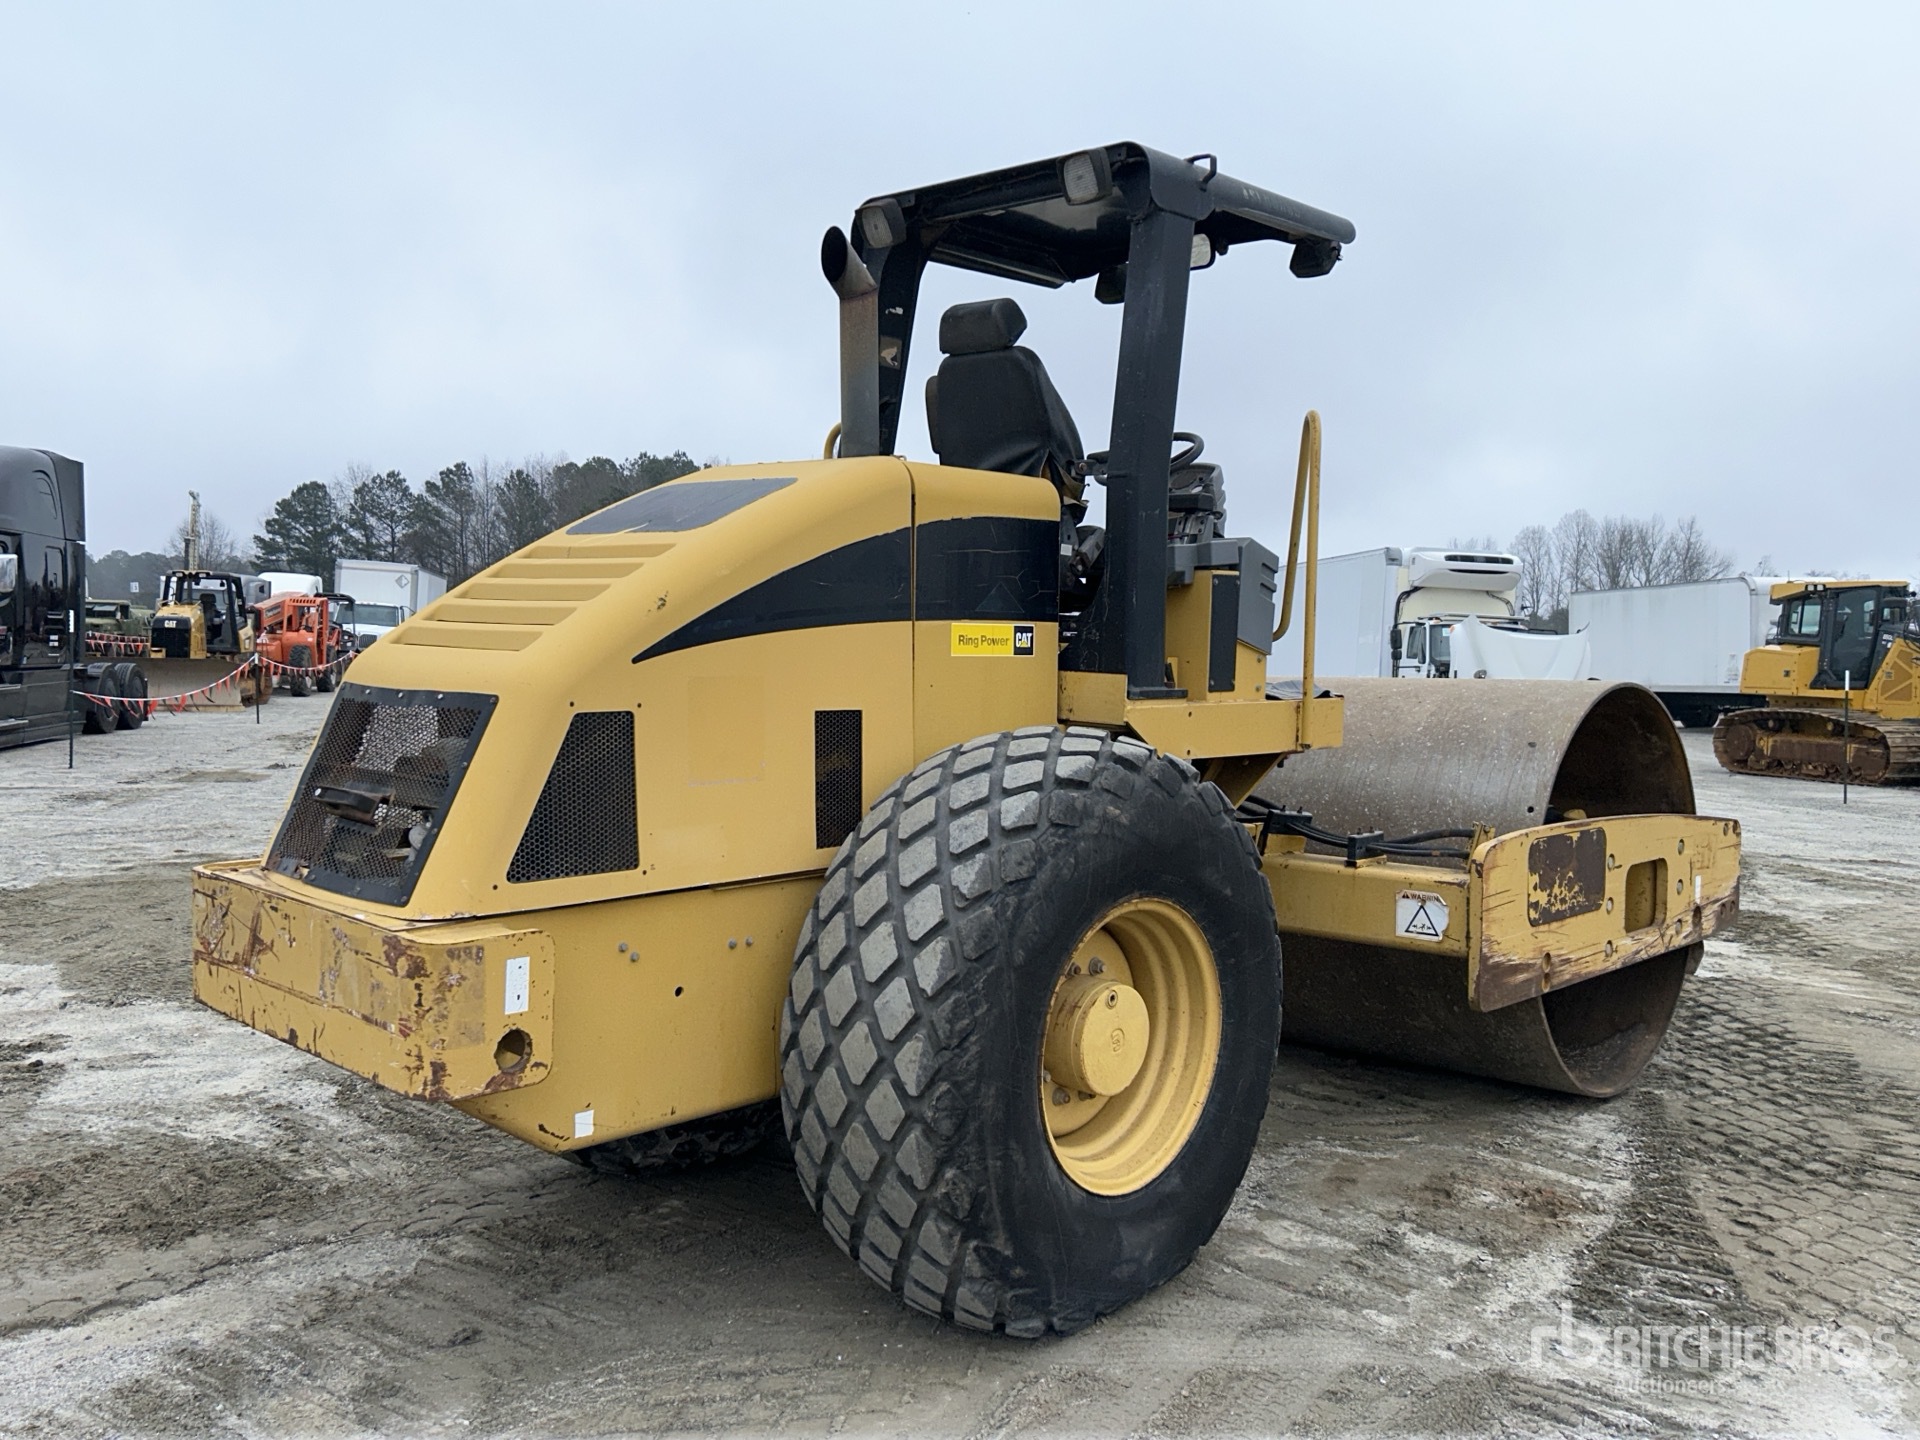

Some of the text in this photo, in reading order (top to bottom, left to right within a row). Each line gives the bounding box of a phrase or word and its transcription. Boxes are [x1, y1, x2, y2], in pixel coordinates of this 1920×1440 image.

[958, 634, 1010, 649] Ring Power
[1015, 632, 1033, 648] CAT
[1410, 892, 1442, 903] WARNIN
